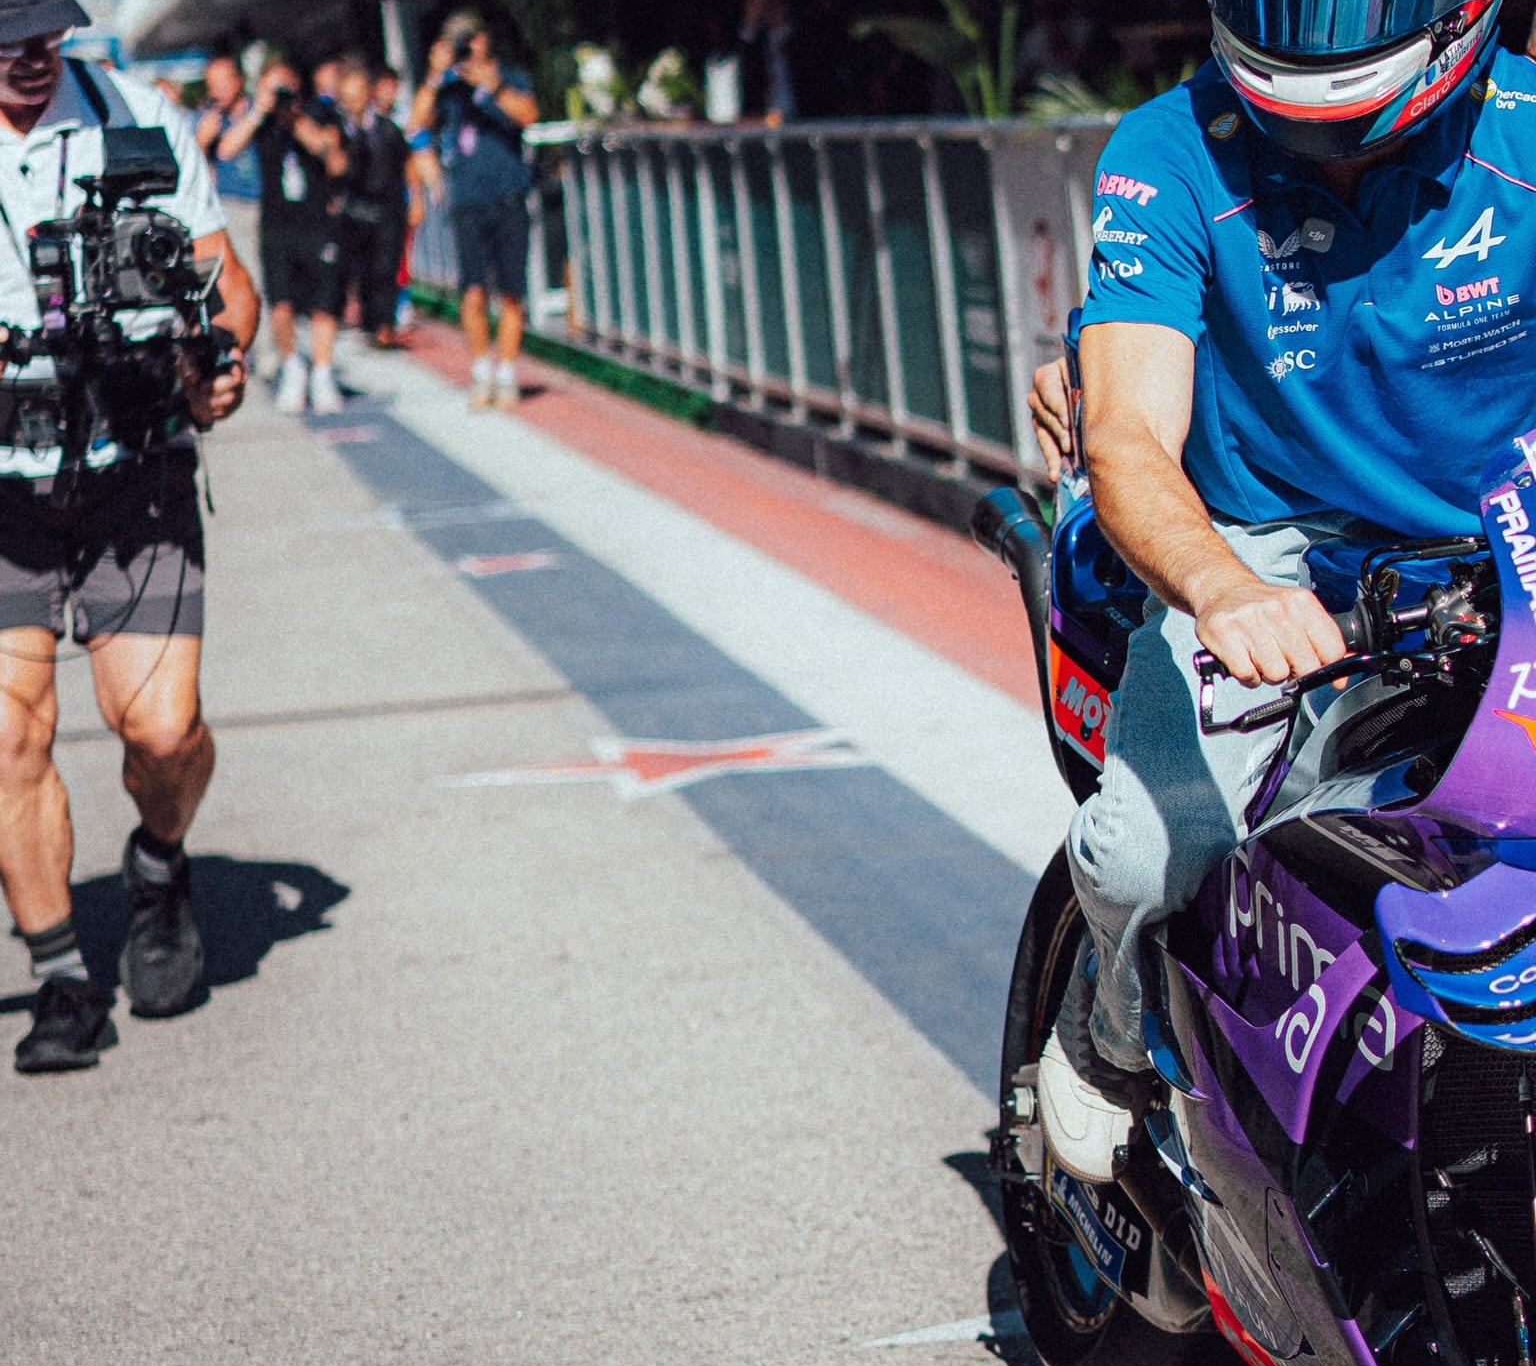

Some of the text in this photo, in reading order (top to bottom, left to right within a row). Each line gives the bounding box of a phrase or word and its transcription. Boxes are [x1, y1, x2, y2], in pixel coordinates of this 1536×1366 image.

[1410, 80, 1451, 117] Claro
[1495, 97, 1516, 111] bre
[1103, 174, 1158, 207] BWT
[1456, 275, 1500, 304] BWT
[1424, 294, 1521, 323] ALPINE
[1437, 309, 1511, 333] FORMULA ONE TEAM
[1068, 1194, 1113, 1267] MICHELIN
